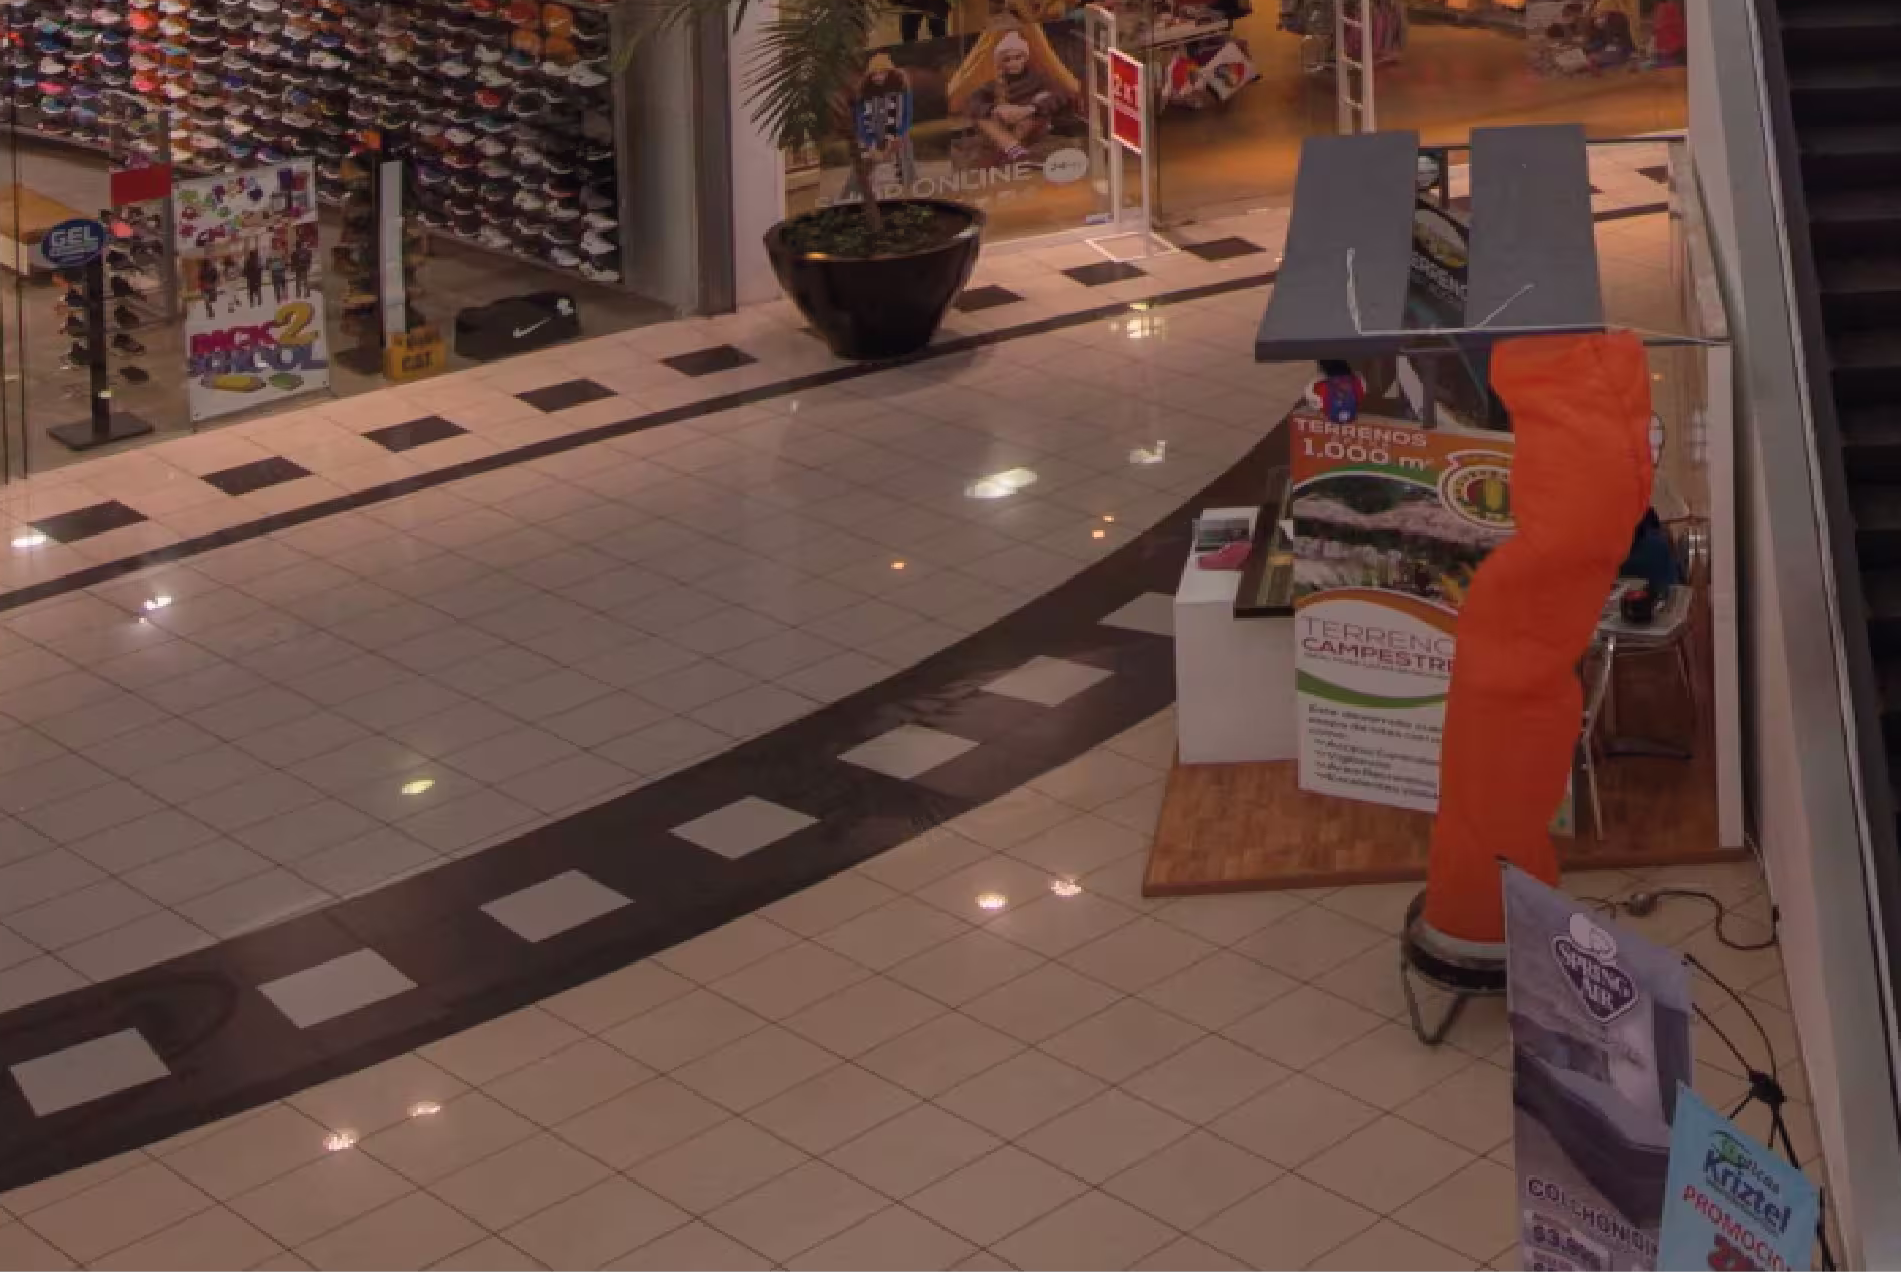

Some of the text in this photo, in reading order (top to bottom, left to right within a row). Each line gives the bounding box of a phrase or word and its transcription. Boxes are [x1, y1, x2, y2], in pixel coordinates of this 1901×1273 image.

[911, 162, 1034, 198] ONLINE
[51, 224, 97, 249] GEL
[274, 301, 319, 347] 2
[1293, 415, 1427, 447] TERRENOS
[1703, 1149, 1793, 1234] Kriztel
